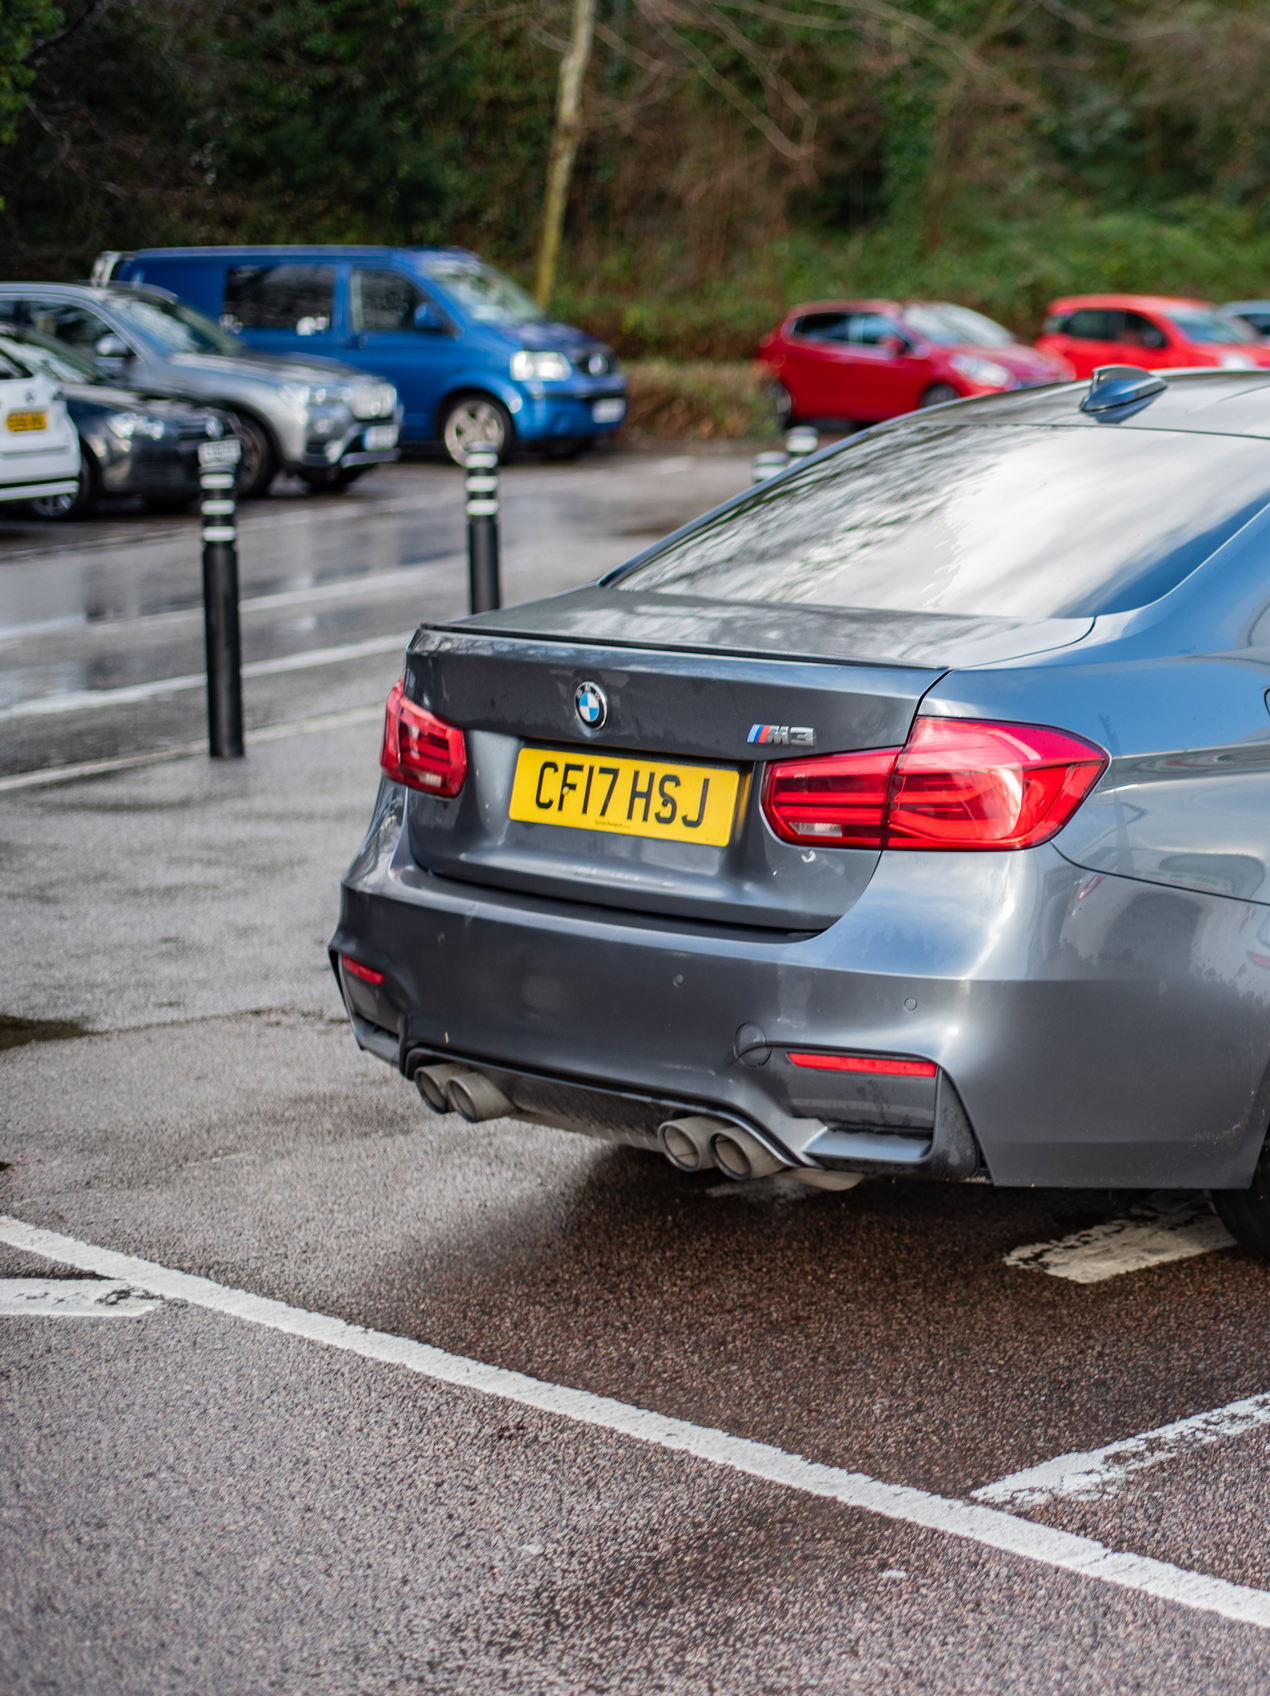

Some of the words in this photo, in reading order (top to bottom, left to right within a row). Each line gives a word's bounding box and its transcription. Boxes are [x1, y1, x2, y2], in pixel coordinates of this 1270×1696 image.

[762, 725, 815, 747] M3
[535, 761, 620, 817] CF17
[626, 770, 710, 828] HSJ
